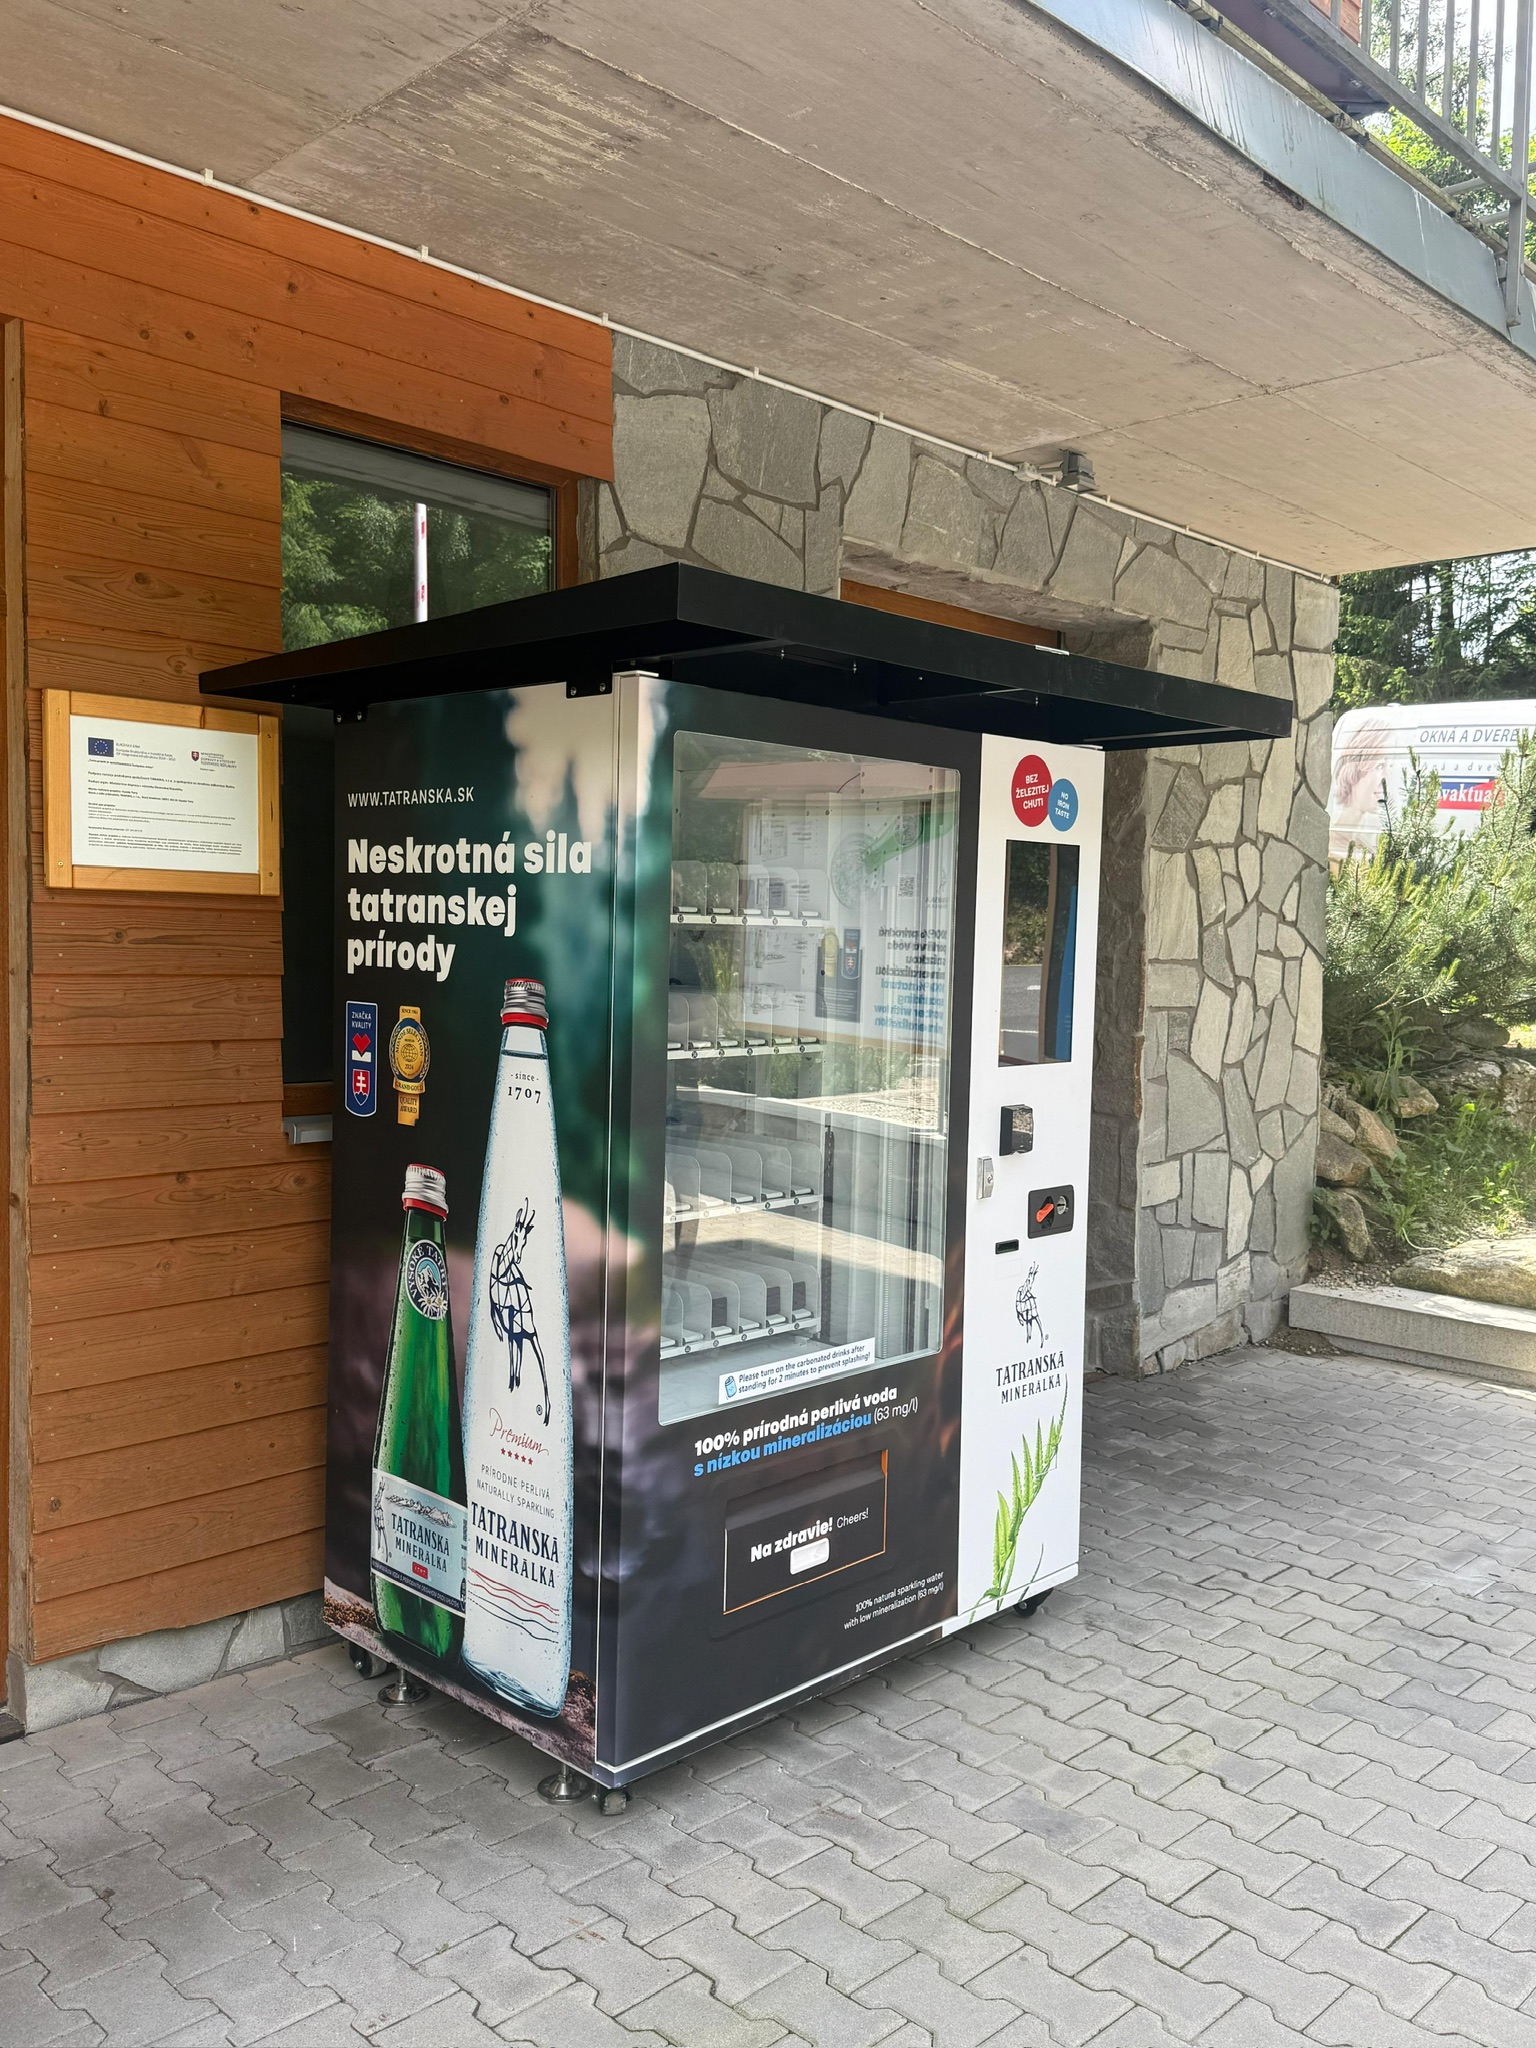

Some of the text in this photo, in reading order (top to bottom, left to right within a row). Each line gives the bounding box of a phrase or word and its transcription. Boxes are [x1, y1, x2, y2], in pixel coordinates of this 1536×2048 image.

[1419, 726, 1519, 743] OKNÁ A DVERE
[347, 786, 475, 808] WWW.TATRANSKA.SK
[1015, 784, 1049, 798] ŽELEZITEJ
[1025, 773, 1038, 784] BEZ
[1060, 791, 1069, 800] NO
[1022, 798, 1044, 809] CHUTI
[1054, 807, 1070, 819] TASTE
[1057, 799, 1070, 810] IRON
[347, 829, 592, 875] Neskrotná sila
[347, 884, 517, 937] tatranskej
[347, 929, 456, 982] prírody
[351, 1011, 372, 1020] ZNAČKA
[351, 1021, 371, 1029] KVALITY
[515, 1071, 535, 1081] since
[399, 1096, 417, 1105] QUALITY
[507, 1086, 541, 1104] 1707
[408, 1244, 425, 1299] VYSOKÉ
[738, 1345, 865, 1384] Please turn on the carbonated drinks after
[738, 1351, 871, 1394] standing for 2 minutes to prevent splashing!
[996, 1350, 1065, 1387] TATRANSKÁ
[1000, 1373, 1061, 1405] MINERÁLKA
[489, 1407, 549, 1456] Premium
[693, 1397, 919, 1477] s nízkou mineralizáciou (63 mg/l)
[694, 1386, 898, 1457] 100% prírodná perlivá voda
[476, 1478, 555, 1519] NATURALLY SPARKLING
[481, 1463, 551, 1500] PRÍRODNE PERLIVÁ
[391, 1513, 450, 1557] TATRANSKÁ
[471, 1501, 559, 1564] TATRANSKÁ
[750, 1507, 869, 1563] Na zdravie! Cheers!
[395, 1536, 447, 1573] MINERÁLKA
[475, 1535, 555, 1589] MINERÁLKA
[843, 1581, 944, 1630] with low mineralization (63 mg/l)
[855, 1571, 944, 1613] 100% natural sparkling water
